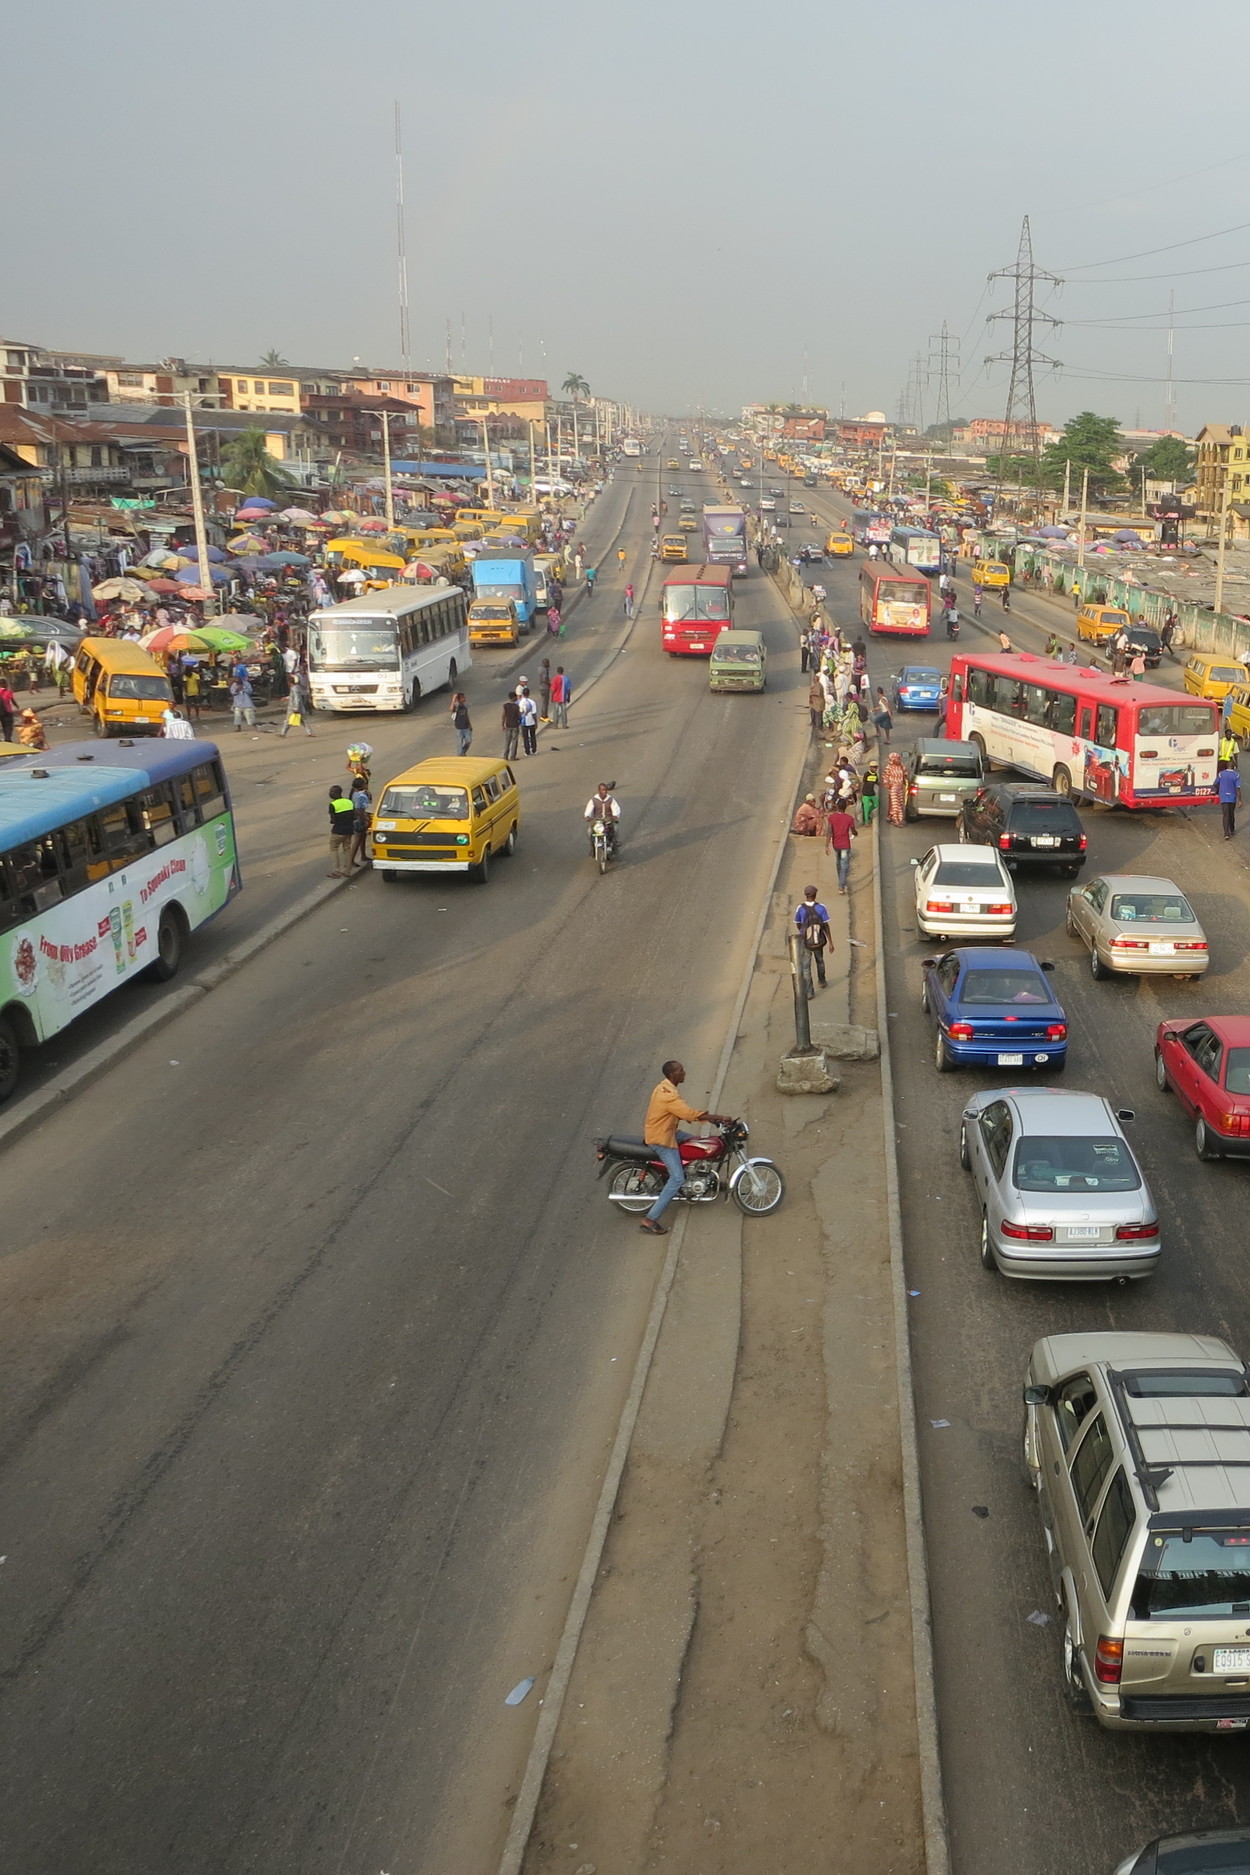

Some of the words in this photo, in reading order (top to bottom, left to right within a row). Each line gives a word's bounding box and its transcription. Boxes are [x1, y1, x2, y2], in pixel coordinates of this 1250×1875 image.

[140, 889, 148, 904] To
[147, 867, 171, 895] Squeaky
[170, 859, 186, 875] Clean
[40, 935, 58, 960] From
[74, 936, 97, 960] Grease
